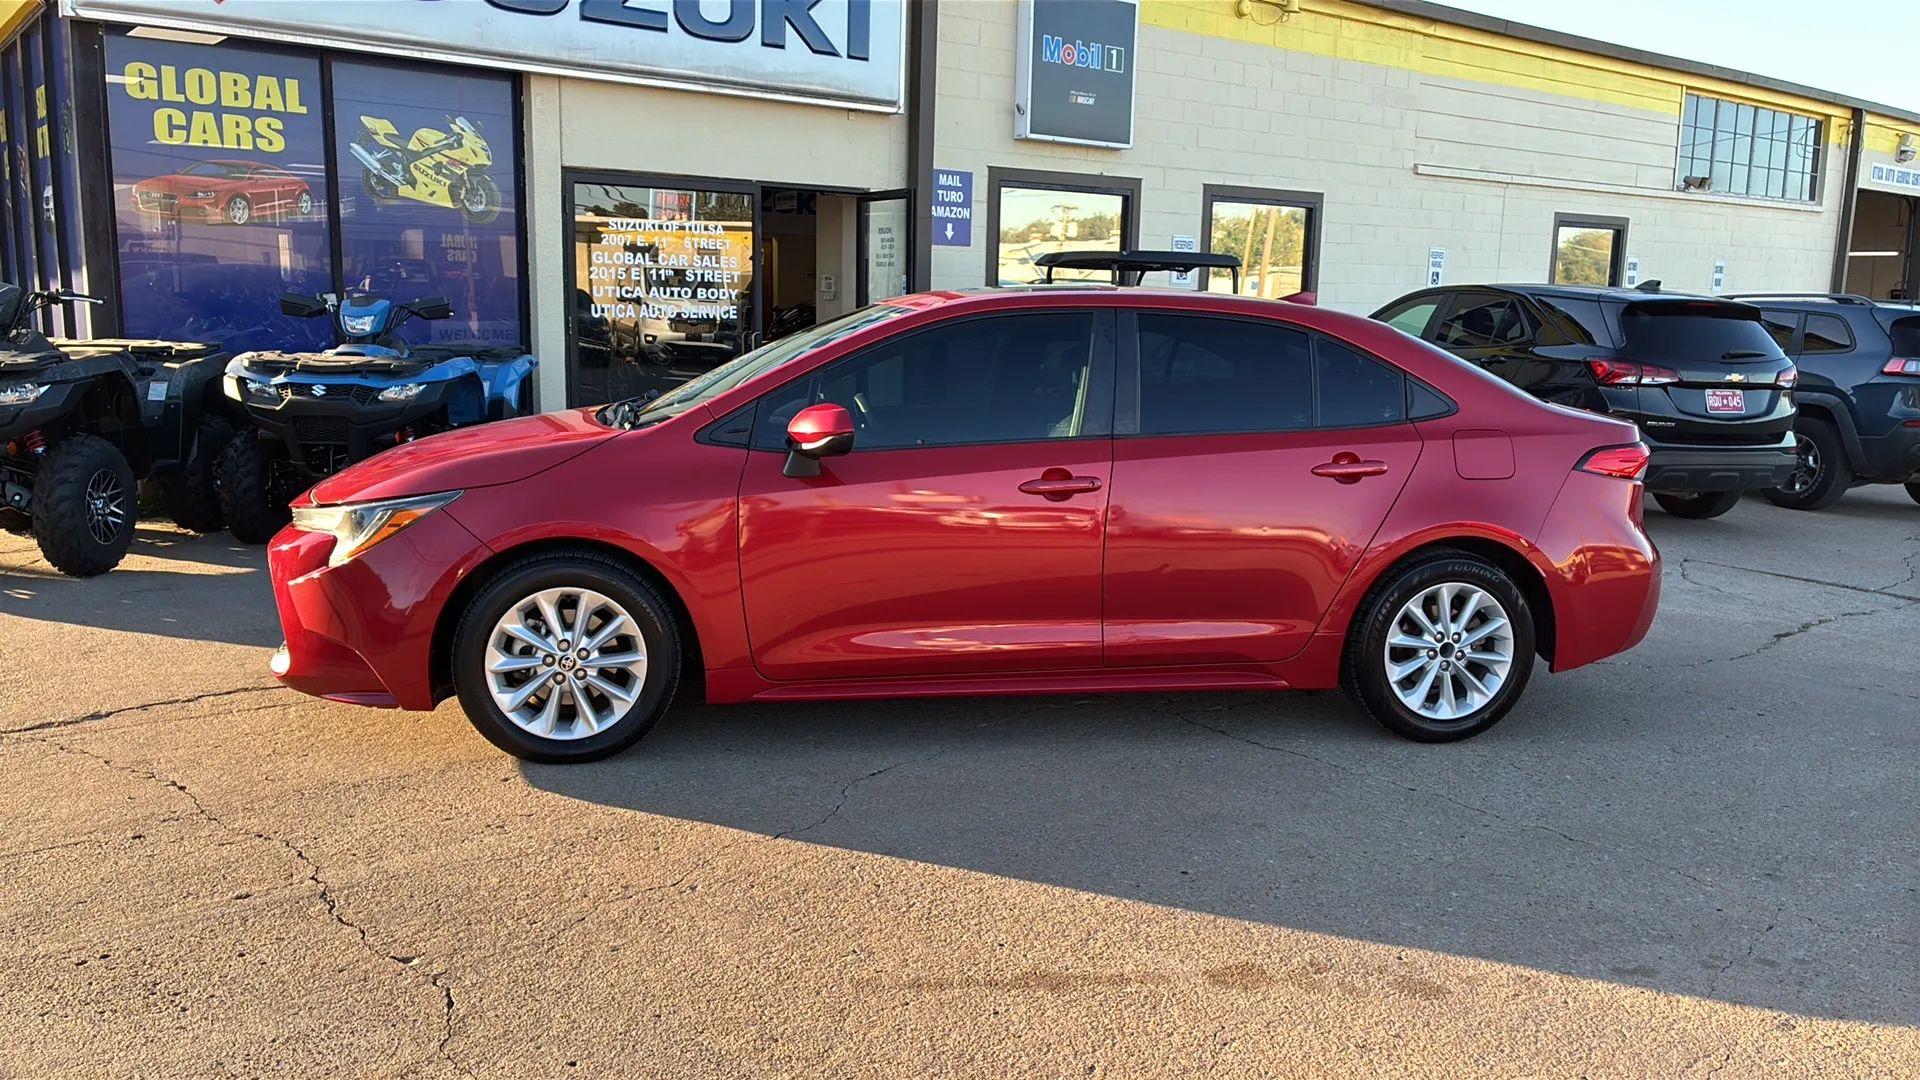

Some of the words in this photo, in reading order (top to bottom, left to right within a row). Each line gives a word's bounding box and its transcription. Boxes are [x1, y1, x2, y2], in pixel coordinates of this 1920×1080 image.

[417, 0, 870, 62] UKI
[1042, 34, 1102, 69] Mobil
[124, 61, 308, 114] GLOBAL
[153, 107, 286, 153] CARS
[413, 163, 447, 187] SUZUKI
[939, 173, 963, 187] MAIL
[937, 189, 964, 203] TURO
[931, 205, 971, 219] AMAZON
[608, 219, 660, 232] SUZUKI
[662, 221, 681, 233] OF
[684, 223, 724, 235] TULSA
[600, 234, 632, 246] 2007
[636, 235, 649, 247] E.
[684, 238, 732, 250] STREET
[592, 251, 654, 265] GLOBAL
[657, 253, 688, 266] CAR
[693, 255, 738, 268] SALES
[589, 266, 627, 280] 2015
[649, 268, 674, 282] 11th
[685, 269, 741, 283] STREET
[592, 286, 644, 299] UTICA
[648, 286, 692, 300] AUTO
[696, 288, 739, 301] BODY
[590, 303, 635, 318] UTICA
[639, 304, 677, 319] AUTO
[680, 304, 738, 320] SERVICE
[438, 327, 514, 341] WELCOME
[1728, 396, 1742, 407] 045
